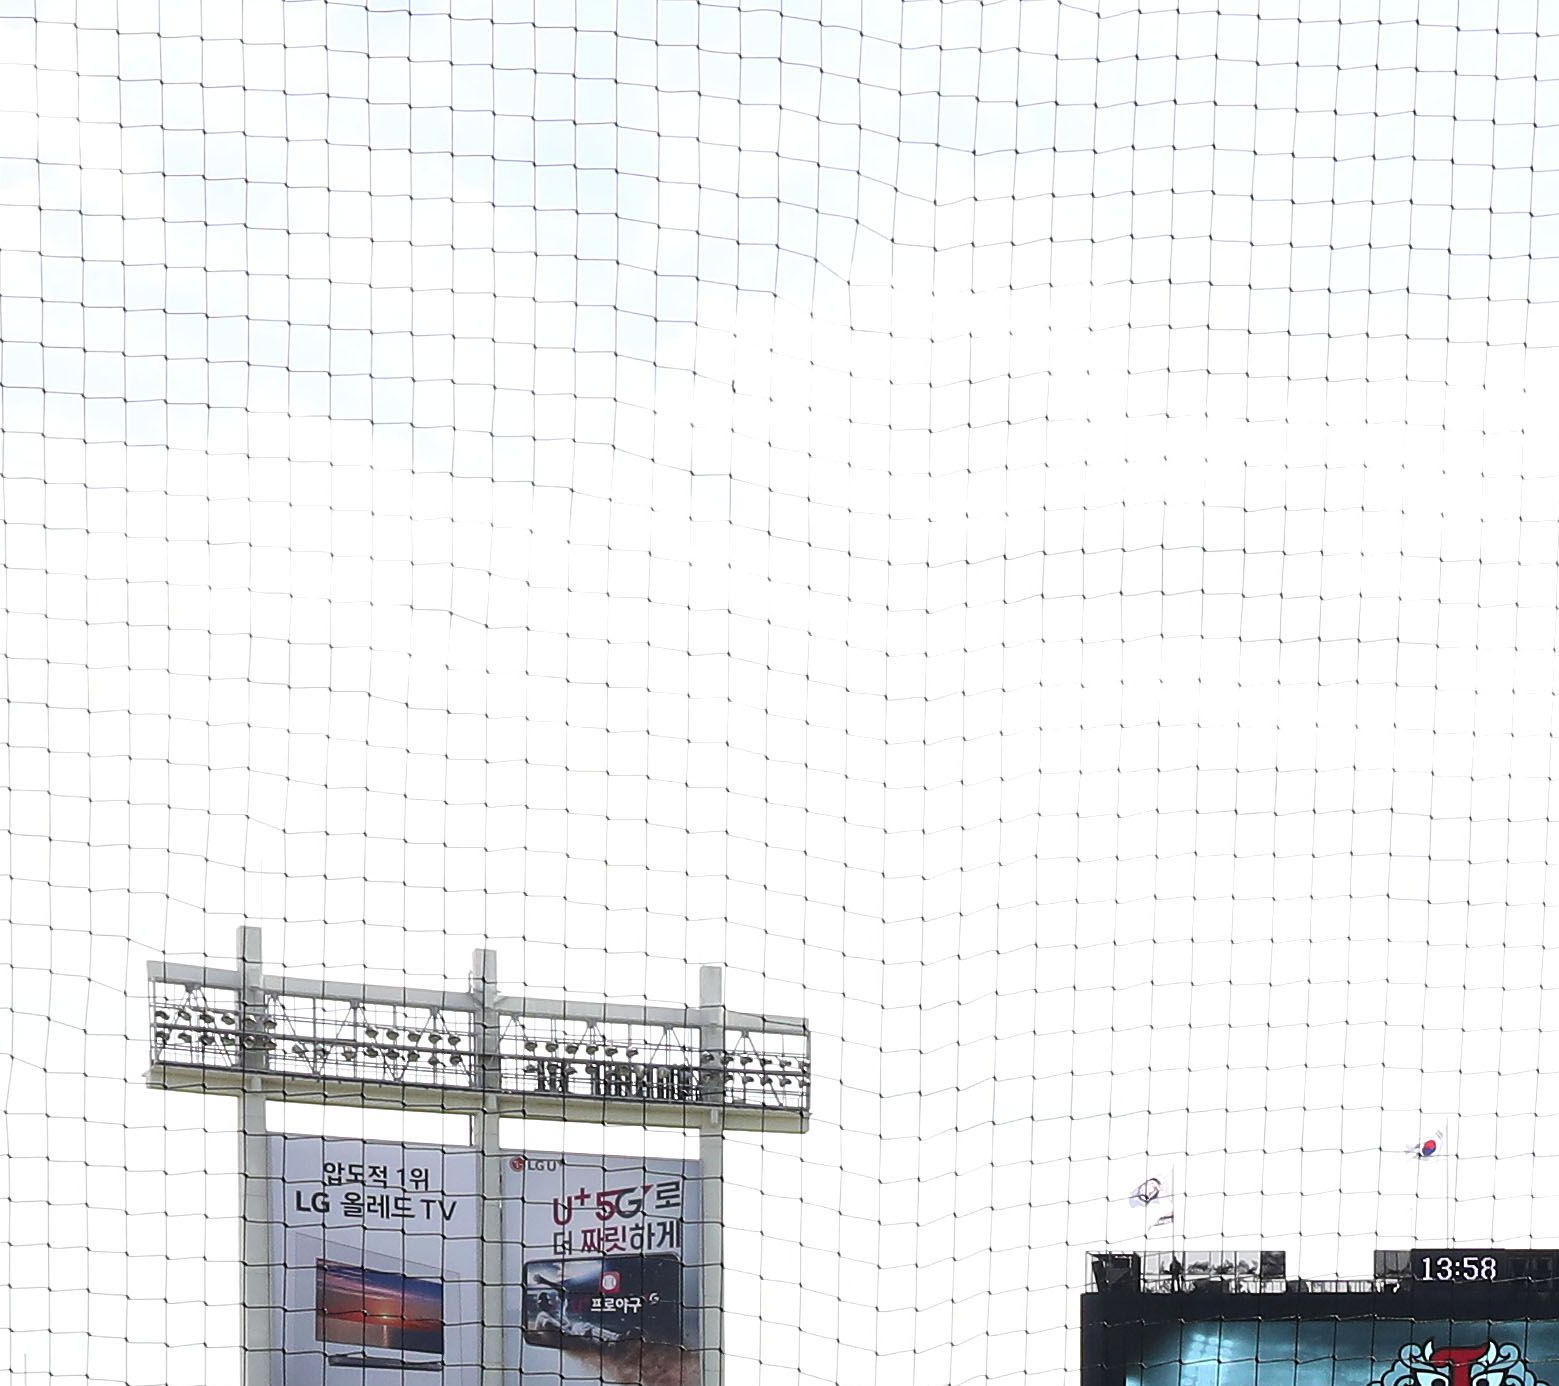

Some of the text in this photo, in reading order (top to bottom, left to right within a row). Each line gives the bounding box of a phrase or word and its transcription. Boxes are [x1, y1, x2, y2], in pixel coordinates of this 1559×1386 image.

[322, 1161, 429, 1191] 압도적 1위
[295, 1190, 458, 1221] LG 올레드 TV
[553, 1220, 681, 1256] 더 짜릿하게
[1419, 1256, 1498, 1282] 13:58
[590, 1297, 642, 1314] 프로야구
